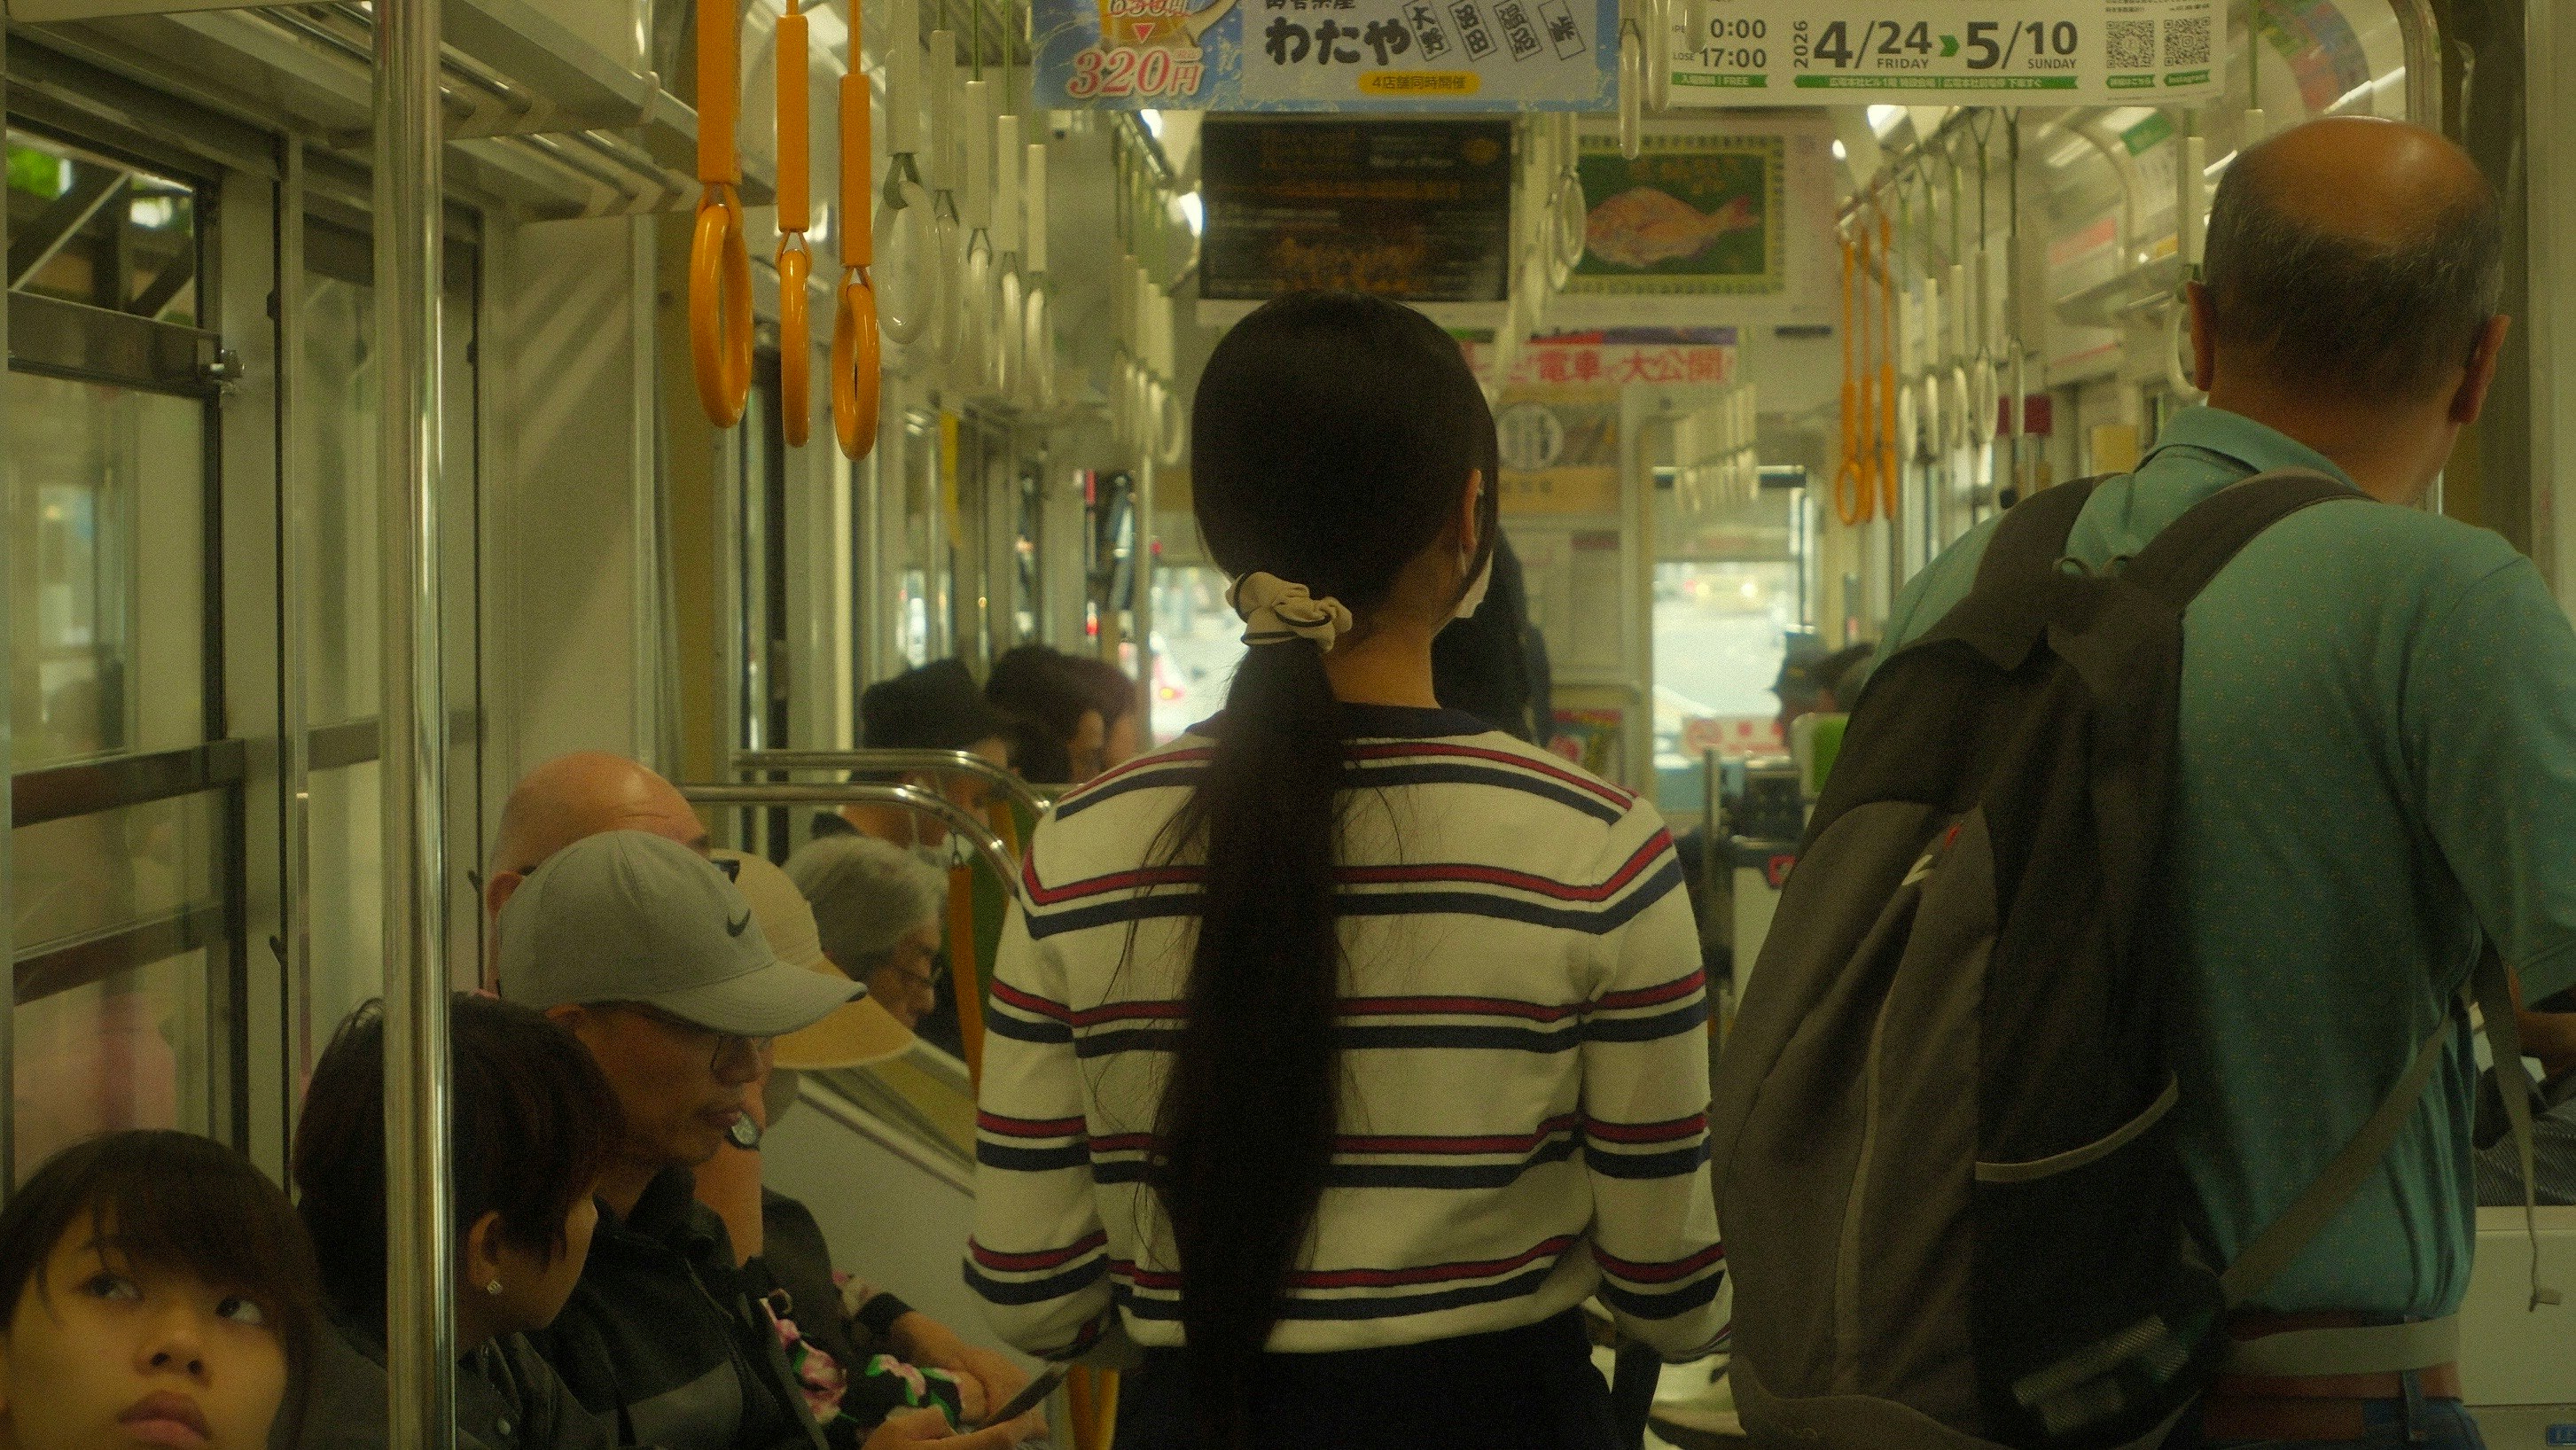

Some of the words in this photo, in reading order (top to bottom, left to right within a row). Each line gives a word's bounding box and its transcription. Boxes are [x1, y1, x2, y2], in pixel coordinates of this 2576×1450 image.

[1711, 19, 1767, 38] 0:00
[1265, 16, 1410, 66] わたや
[1793, 19, 1809, 69] 2026
[1813, 19, 1932, 70] 4/24
[1965, 19, 2079, 70] 5/10
[1673, 52, 1695, 61] LOSE
[1699, 48, 1767, 67] 17:00
[1877, 58, 1930, 69] FRIDAY
[2027, 58, 2077, 69] SUNDAY
[1068, 50, 1200, 95] 320円
[1724, 76, 1750, 85] FREE
[1371, 75, 1467, 90] 4店舗同時開催
